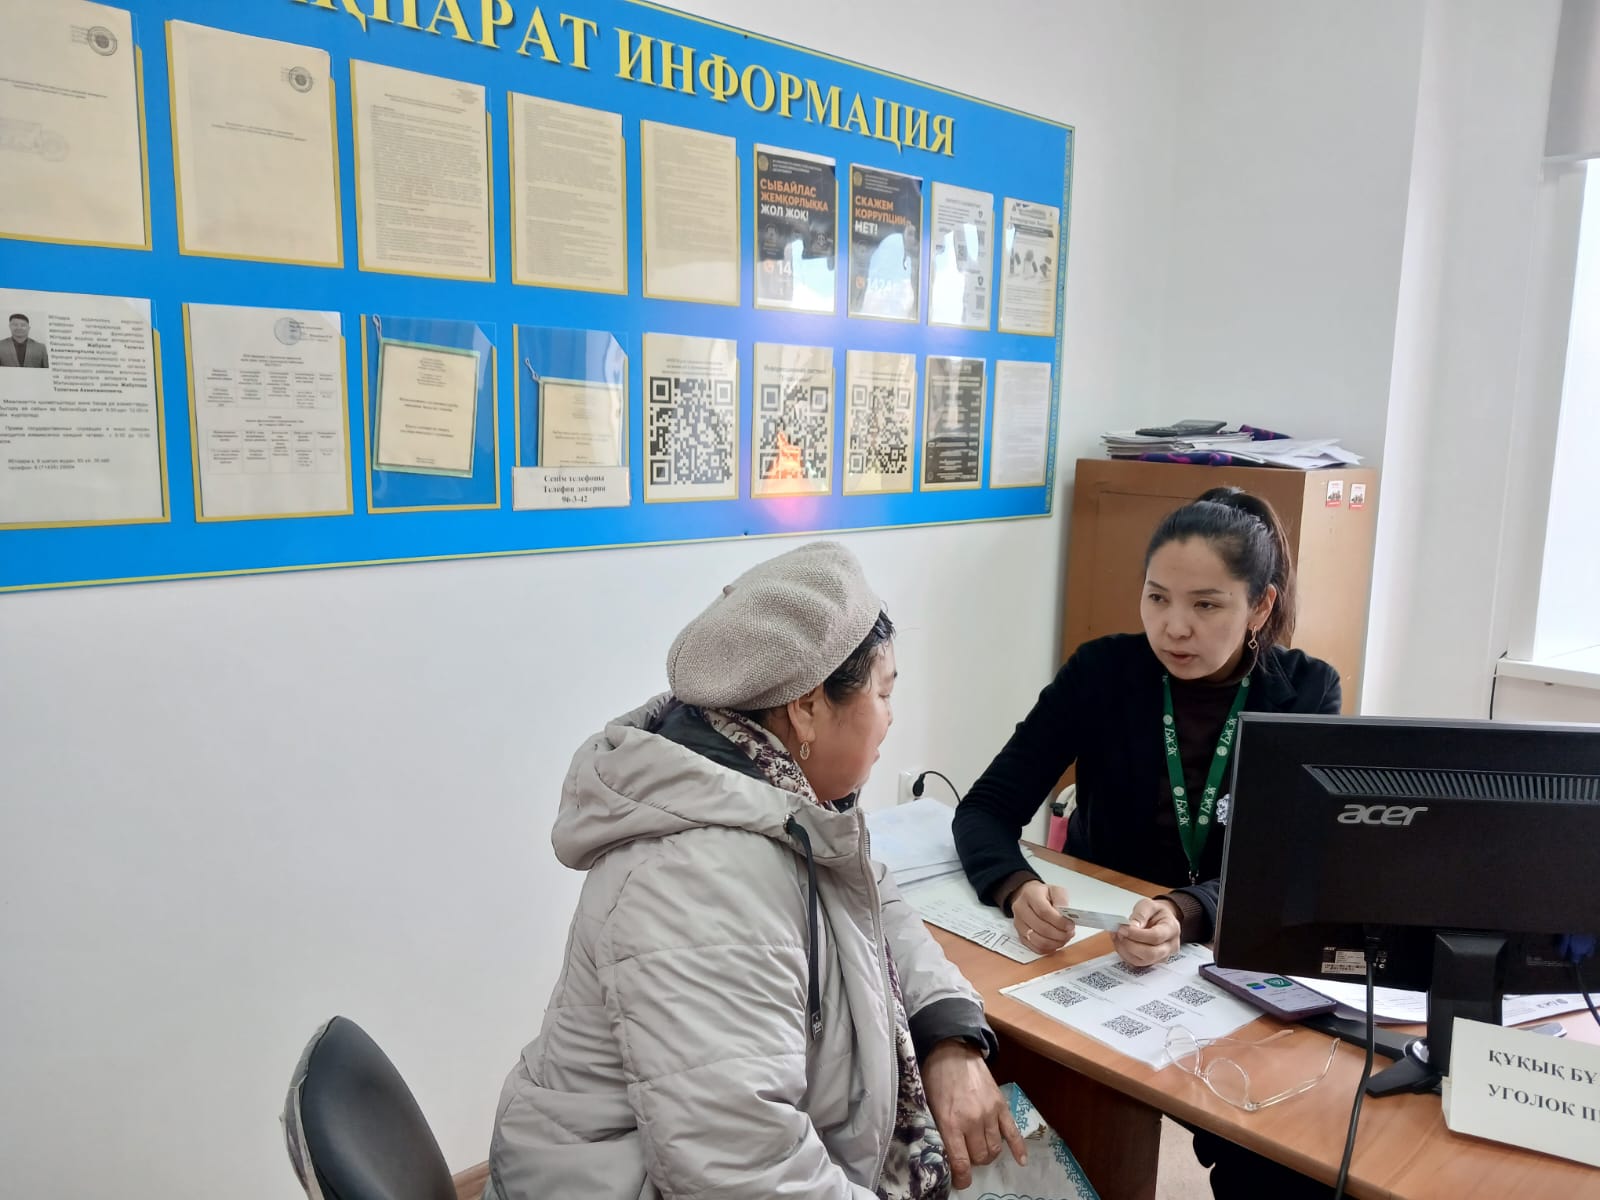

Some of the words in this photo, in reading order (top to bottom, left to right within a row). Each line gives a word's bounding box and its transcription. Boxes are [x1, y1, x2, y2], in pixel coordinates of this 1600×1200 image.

[614, 27, 955, 157] ИНФОРМАЦИЯ
[760, 178, 817, 198] СЫБАЙЛАС
[761, 203, 784, 217] ЖОЛ
[855, 195, 894, 211] СКАЖЕМ
[855, 208, 906, 225] КОРРУПЦИИ
[855, 220, 878, 236] НЕТ!
[1337, 803, 1428, 826] acer
[1488, 1083, 1576, 1117] УГОЛОК
[1583, 1105, 1600, 1123] П
